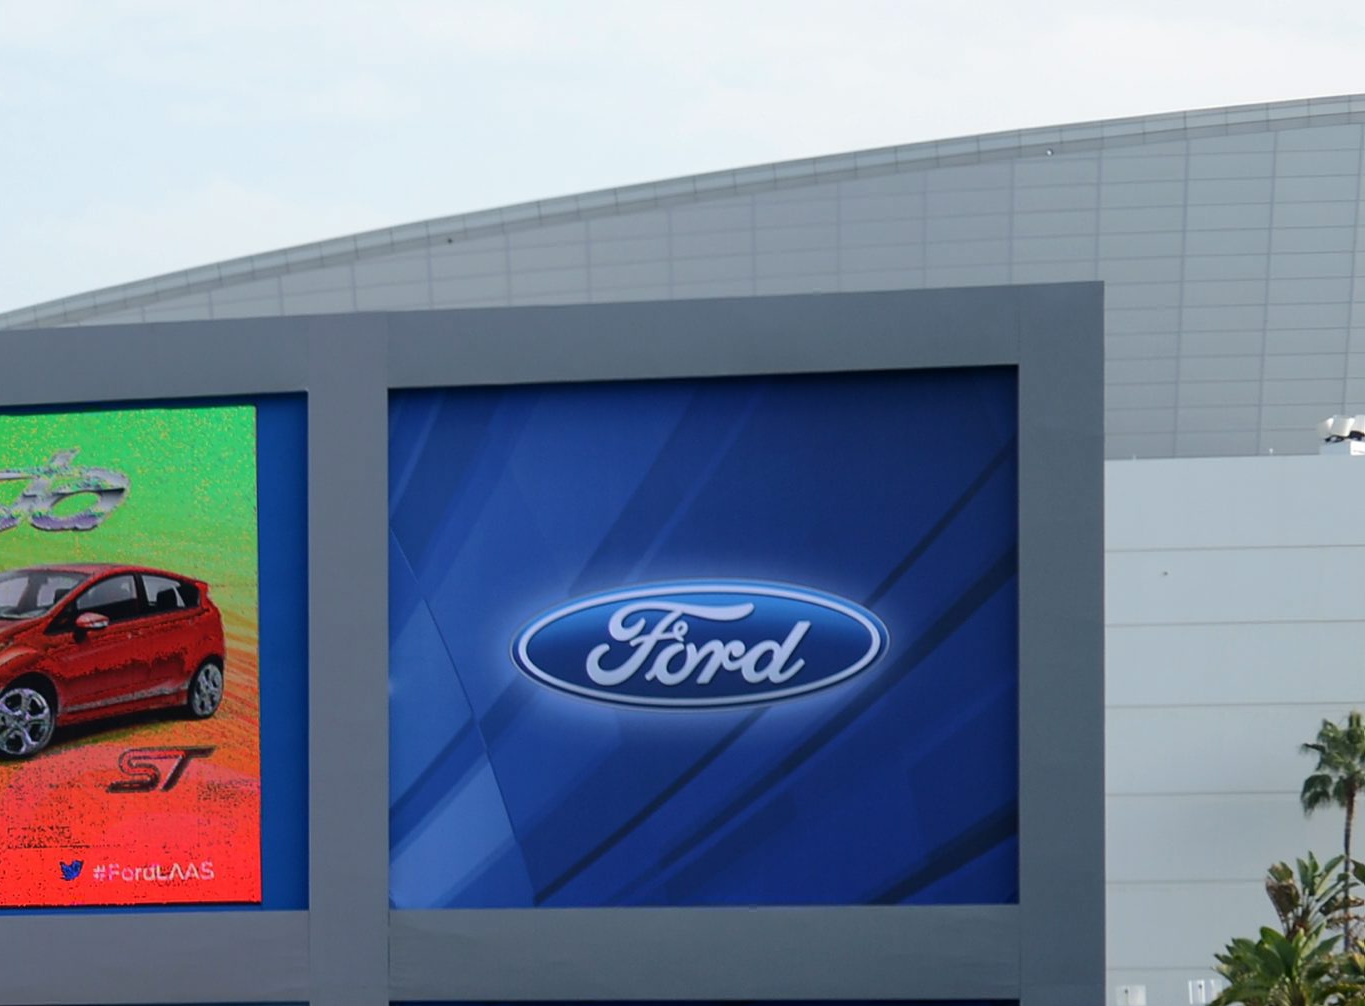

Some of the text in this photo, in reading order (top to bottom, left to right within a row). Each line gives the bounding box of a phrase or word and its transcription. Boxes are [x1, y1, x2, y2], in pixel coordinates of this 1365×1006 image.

[586, 602, 811, 686] Ford
[105, 745, 217, 794] ST
[93, 861, 215, 881] #FordLAAS
